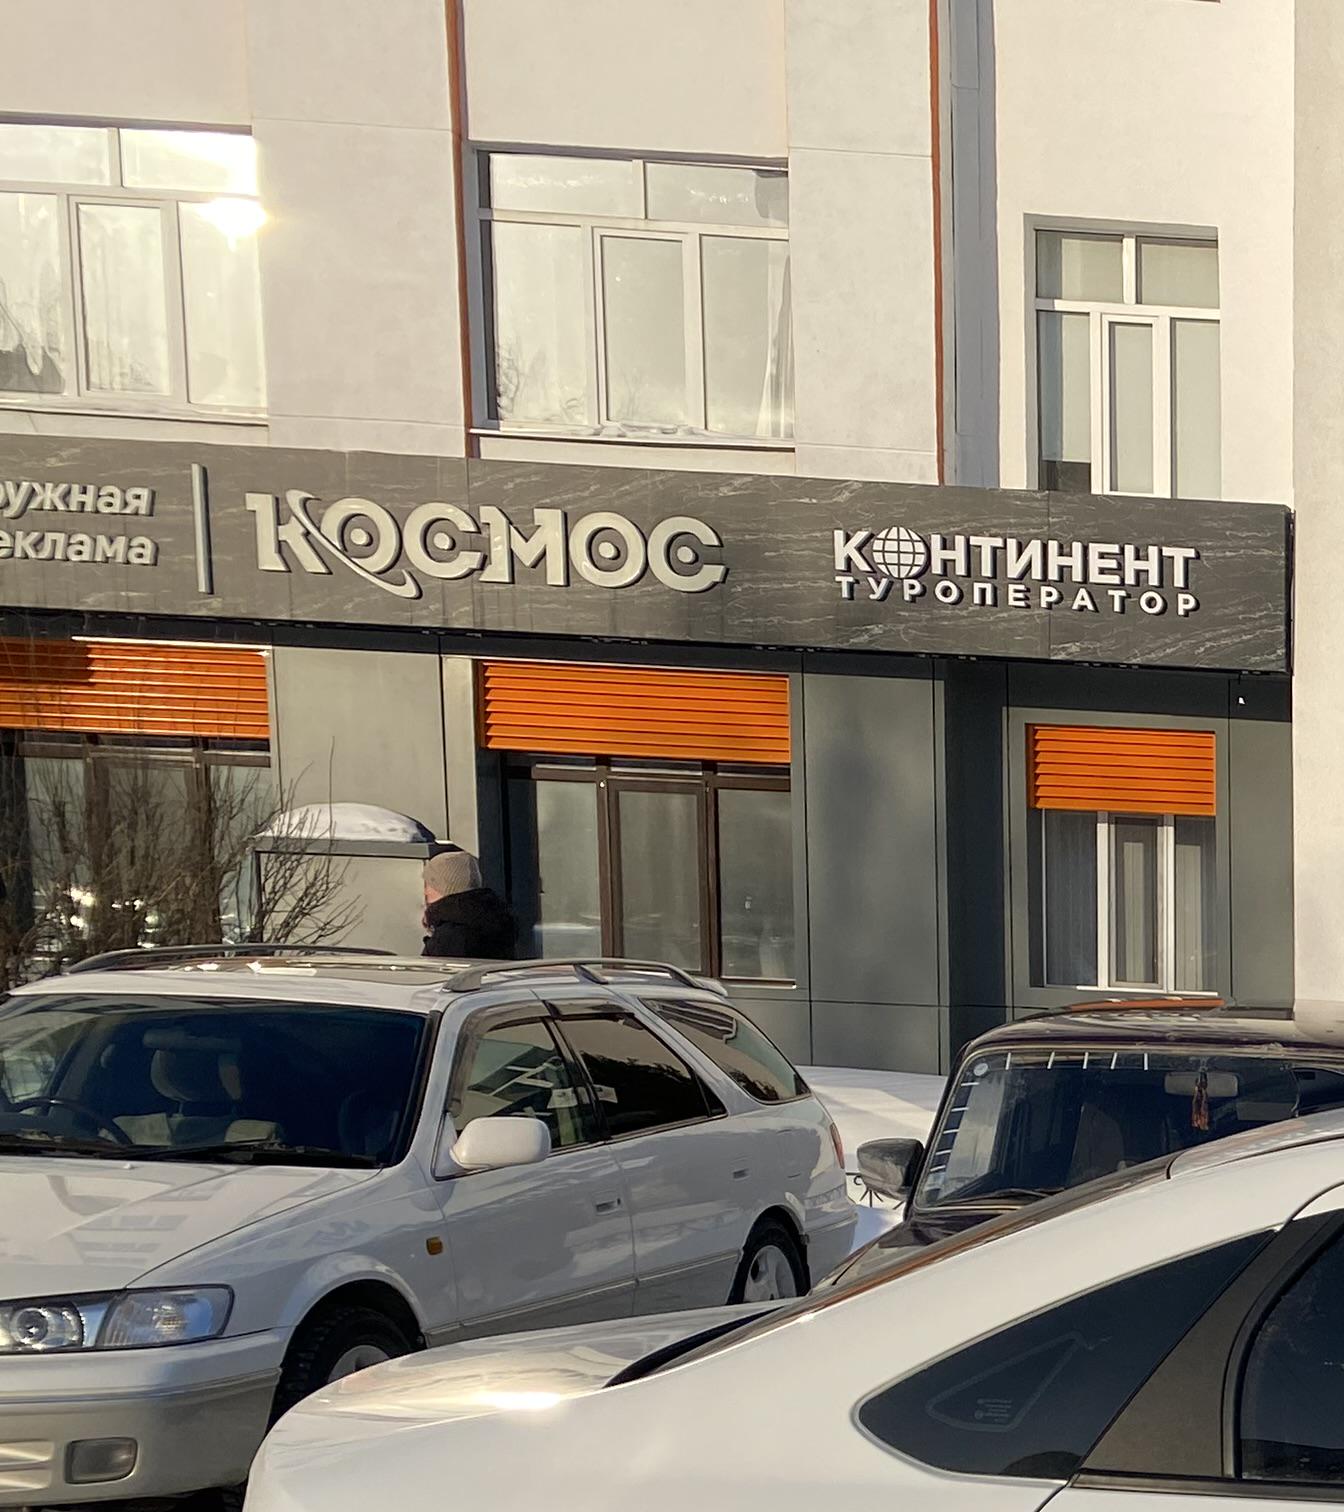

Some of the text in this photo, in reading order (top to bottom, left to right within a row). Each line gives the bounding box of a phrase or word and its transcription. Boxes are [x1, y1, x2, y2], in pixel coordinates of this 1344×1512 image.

[245, 490, 729, 598] КОСМОС
[833, 526, 1200, 588] КОНТИНЕНТ
[835, 576, 1200, 616] ТУРОПЕРАТОР
